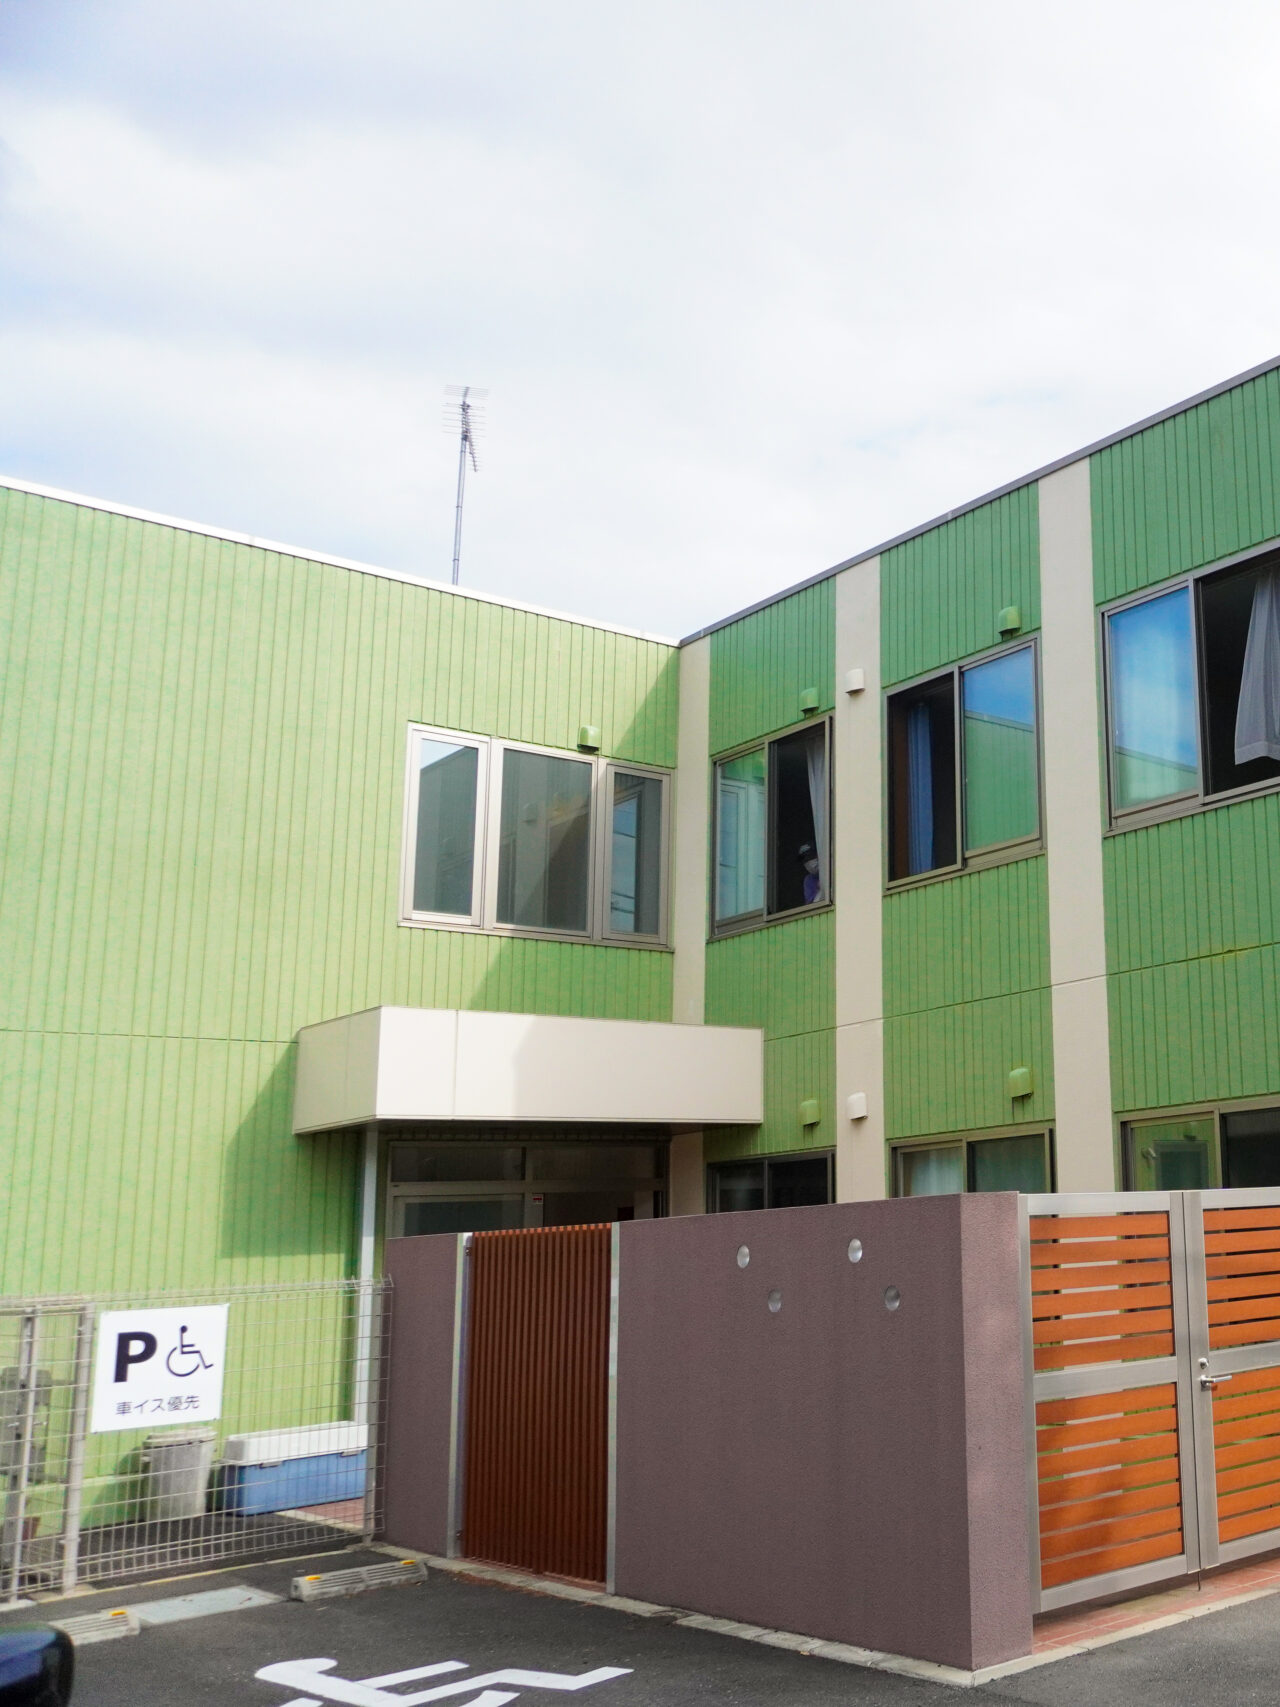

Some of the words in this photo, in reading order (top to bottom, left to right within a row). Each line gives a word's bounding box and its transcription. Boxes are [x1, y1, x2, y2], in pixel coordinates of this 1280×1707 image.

[114, 1331, 157, 1383] P
[115, 1395, 200, 1415] 車イス優先
